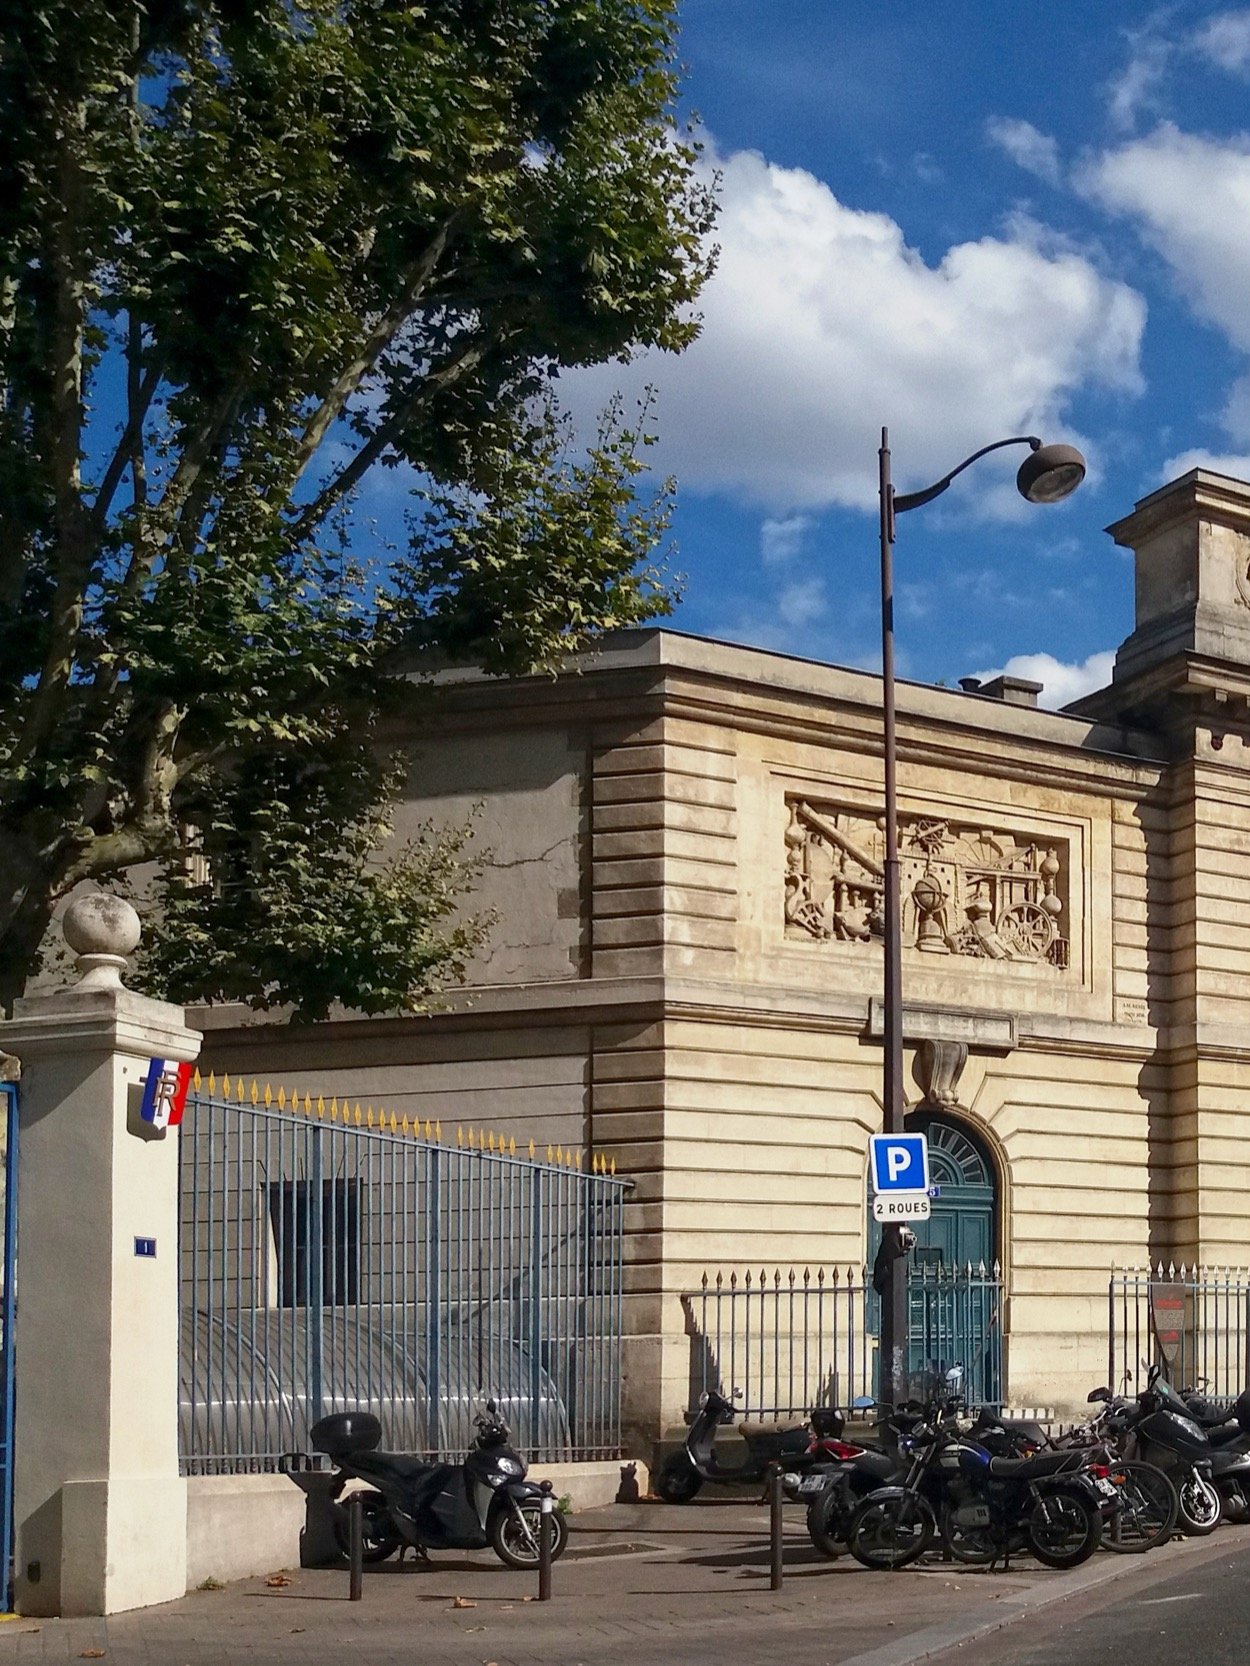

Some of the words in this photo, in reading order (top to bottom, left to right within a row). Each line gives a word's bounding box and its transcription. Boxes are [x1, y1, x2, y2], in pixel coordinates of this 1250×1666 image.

[887, 1147, 911, 1181] P
[876, 1204, 884, 1214] 2
[889, 1202, 928, 1214] ROUES
